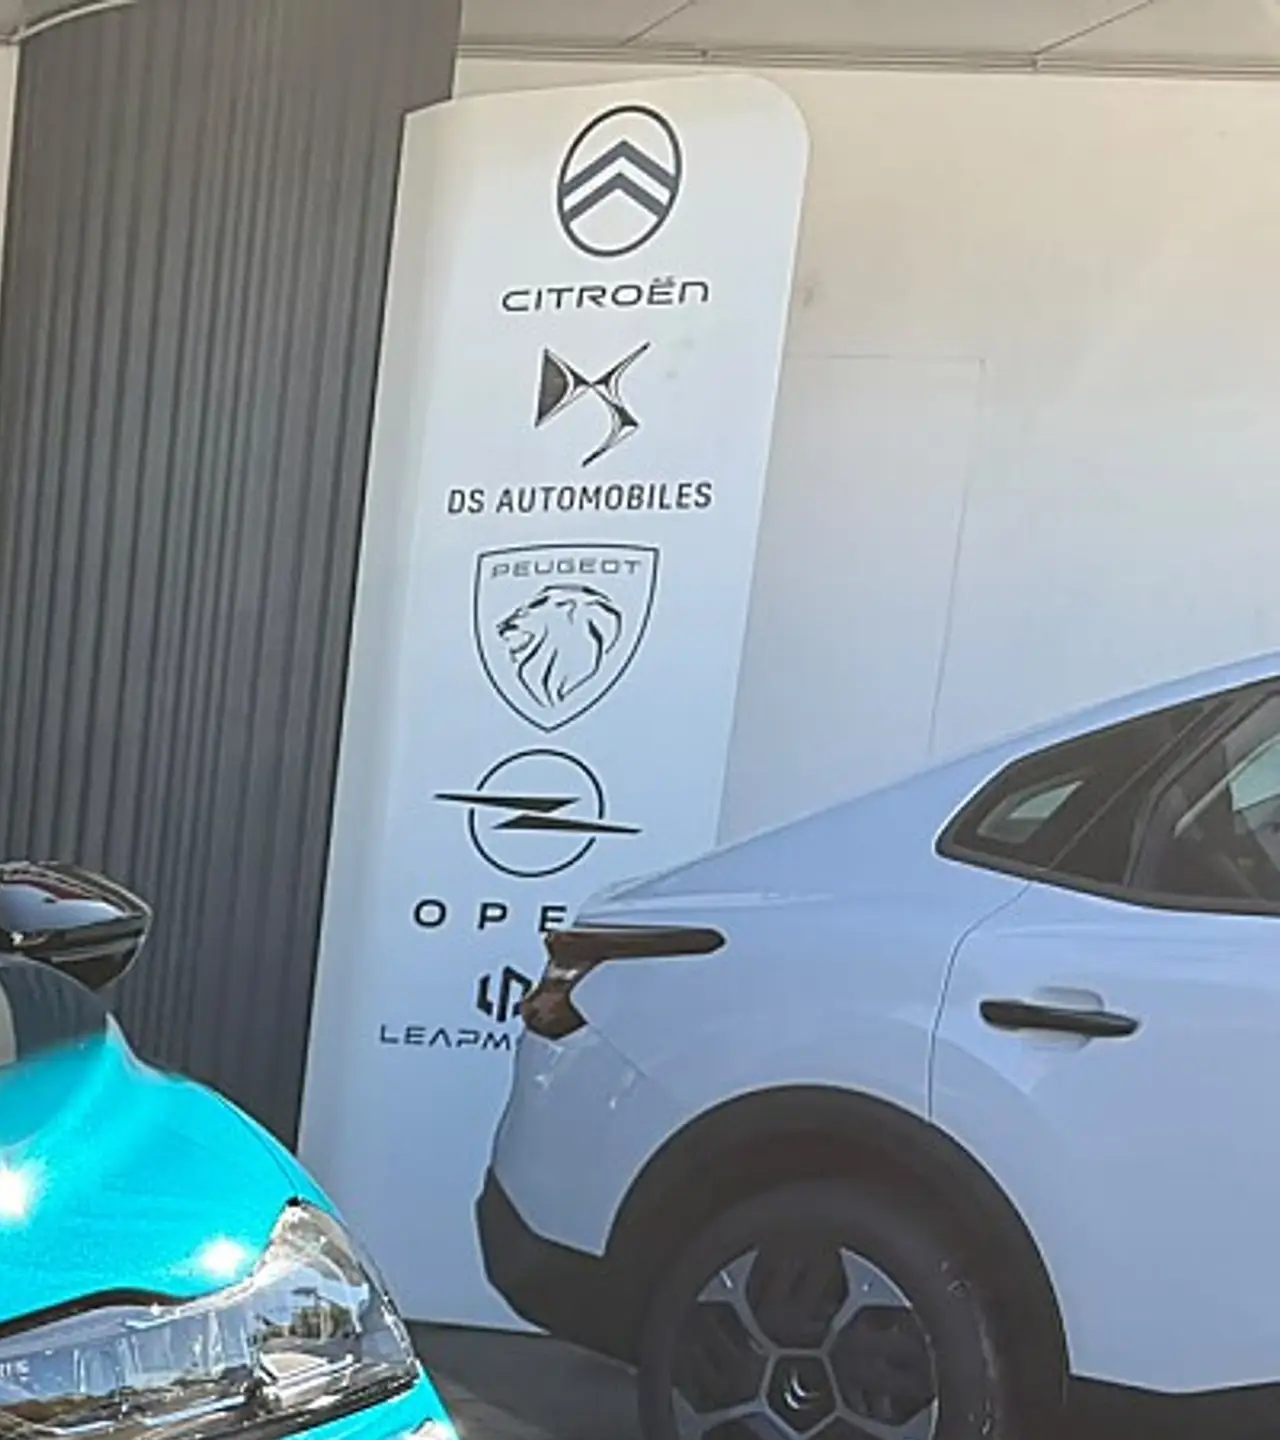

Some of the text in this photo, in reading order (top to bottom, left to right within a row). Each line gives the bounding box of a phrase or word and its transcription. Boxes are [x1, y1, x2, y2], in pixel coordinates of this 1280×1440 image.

[501, 276, 710, 312] CITROËN
[447, 482, 713, 515] DS AUTOMOBILES
[491, 557, 642, 579] PEUGEOT
[413, 898, 568, 933] OPE
[379, 1023, 512, 1051] LEAPM
